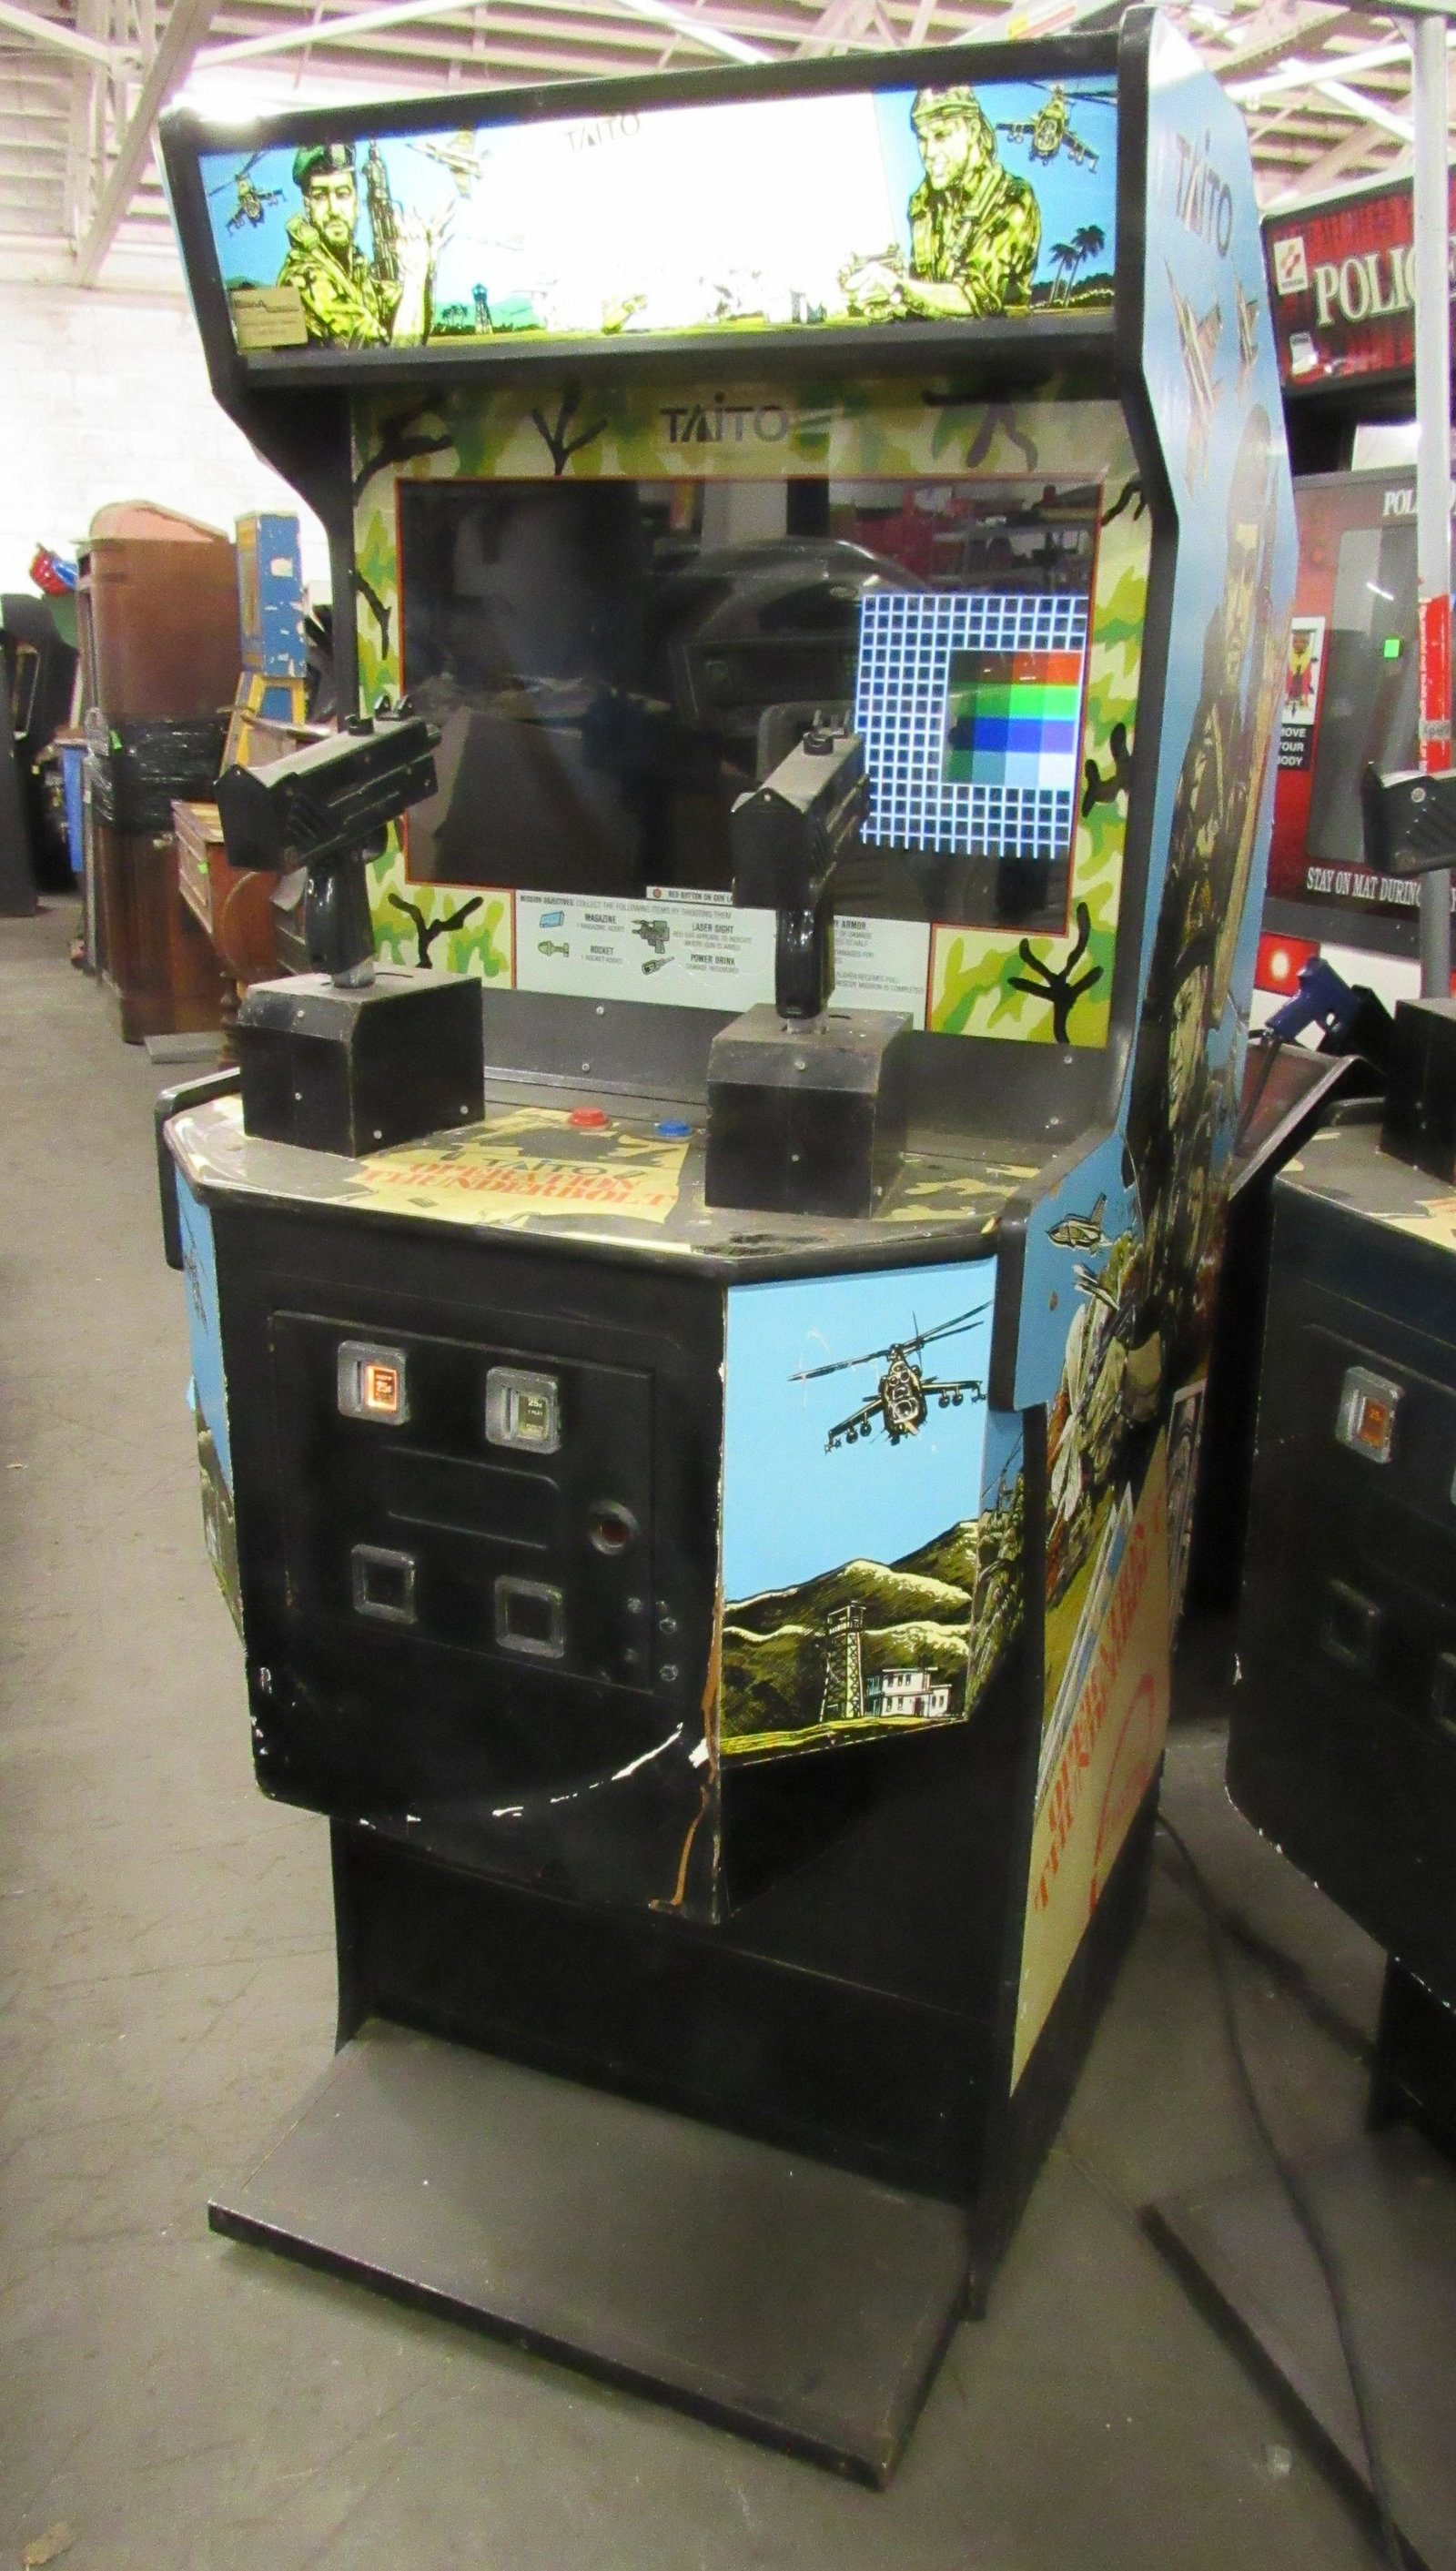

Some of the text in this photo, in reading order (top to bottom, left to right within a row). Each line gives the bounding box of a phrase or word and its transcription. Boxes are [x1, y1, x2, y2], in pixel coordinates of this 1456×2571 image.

[564, 113, 641, 153] TAITO
[659, 391, 791, 444] TAITO
[1279, 742, 1304, 752] OUR
[1307, 865, 1335, 893] STAY
[1335, 870, 1352, 895] ON
[1351, 873, 1379, 900] MAT
[585, 913, 617, 924] MAGAZINE
[841, 920, 867, 931] ARMOR
[693, 922, 734, 935] LASER SIGHT
[591, 946, 614, 956] ROCKET
[690, 954, 736, 967] POWER DRINK
[482, 1159, 608, 1177] TAITO
[410, 1162, 640, 1193] OPERATION
[364, 1169, 678, 1207] THUNDERBOLT
